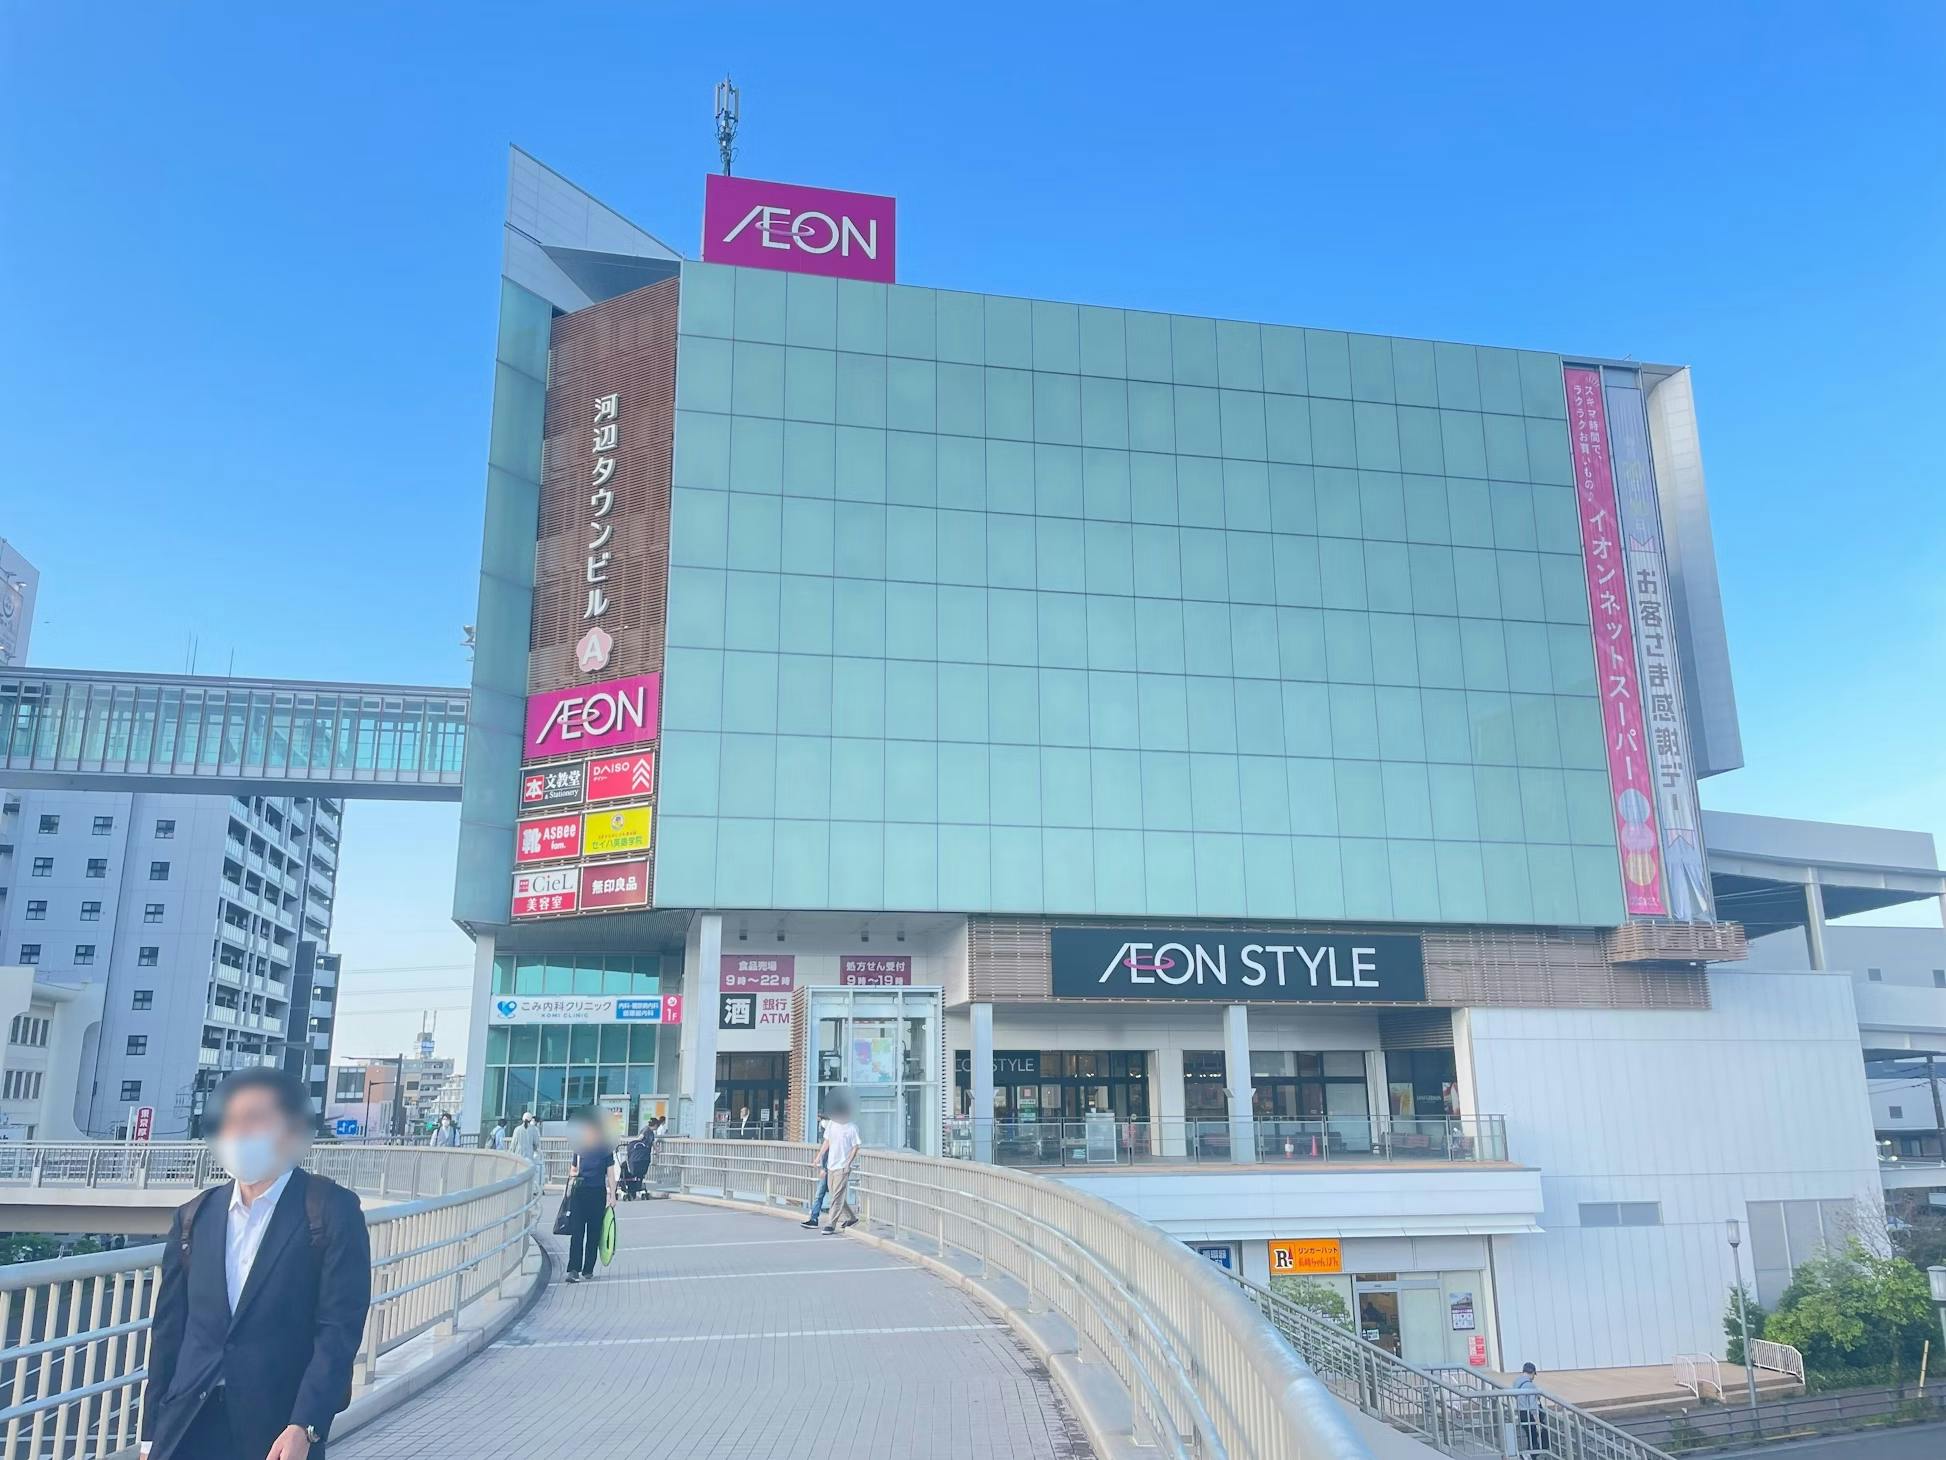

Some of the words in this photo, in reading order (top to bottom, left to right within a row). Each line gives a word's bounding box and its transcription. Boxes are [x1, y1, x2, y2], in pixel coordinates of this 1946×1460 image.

[584, 393, 620, 619] 河辺タウンビル
[1589, 510, 1638, 781] イオンネットスーパー
[1636, 568, 1683, 811] お客さま感謝デー
[593, 761, 631, 776] DAISO
[525, 778, 543, 799] 本
[545, 769, 580, 790] 文教堂
[542, 823, 577, 841] ASBee
[591, 875, 638, 895] 無印良品
[526, 895, 563, 912] 美容室
[846, 961, 906, 972] 処方せん受付
[1241, 943, 1380, 989] STYLE
[520, 1000, 612, 1012] こみ内科クリニック
[724, 998, 751, 1025] 酒
[762, 998, 788, 1011] 銀行
[760, 1013, 790, 1024] ATM
